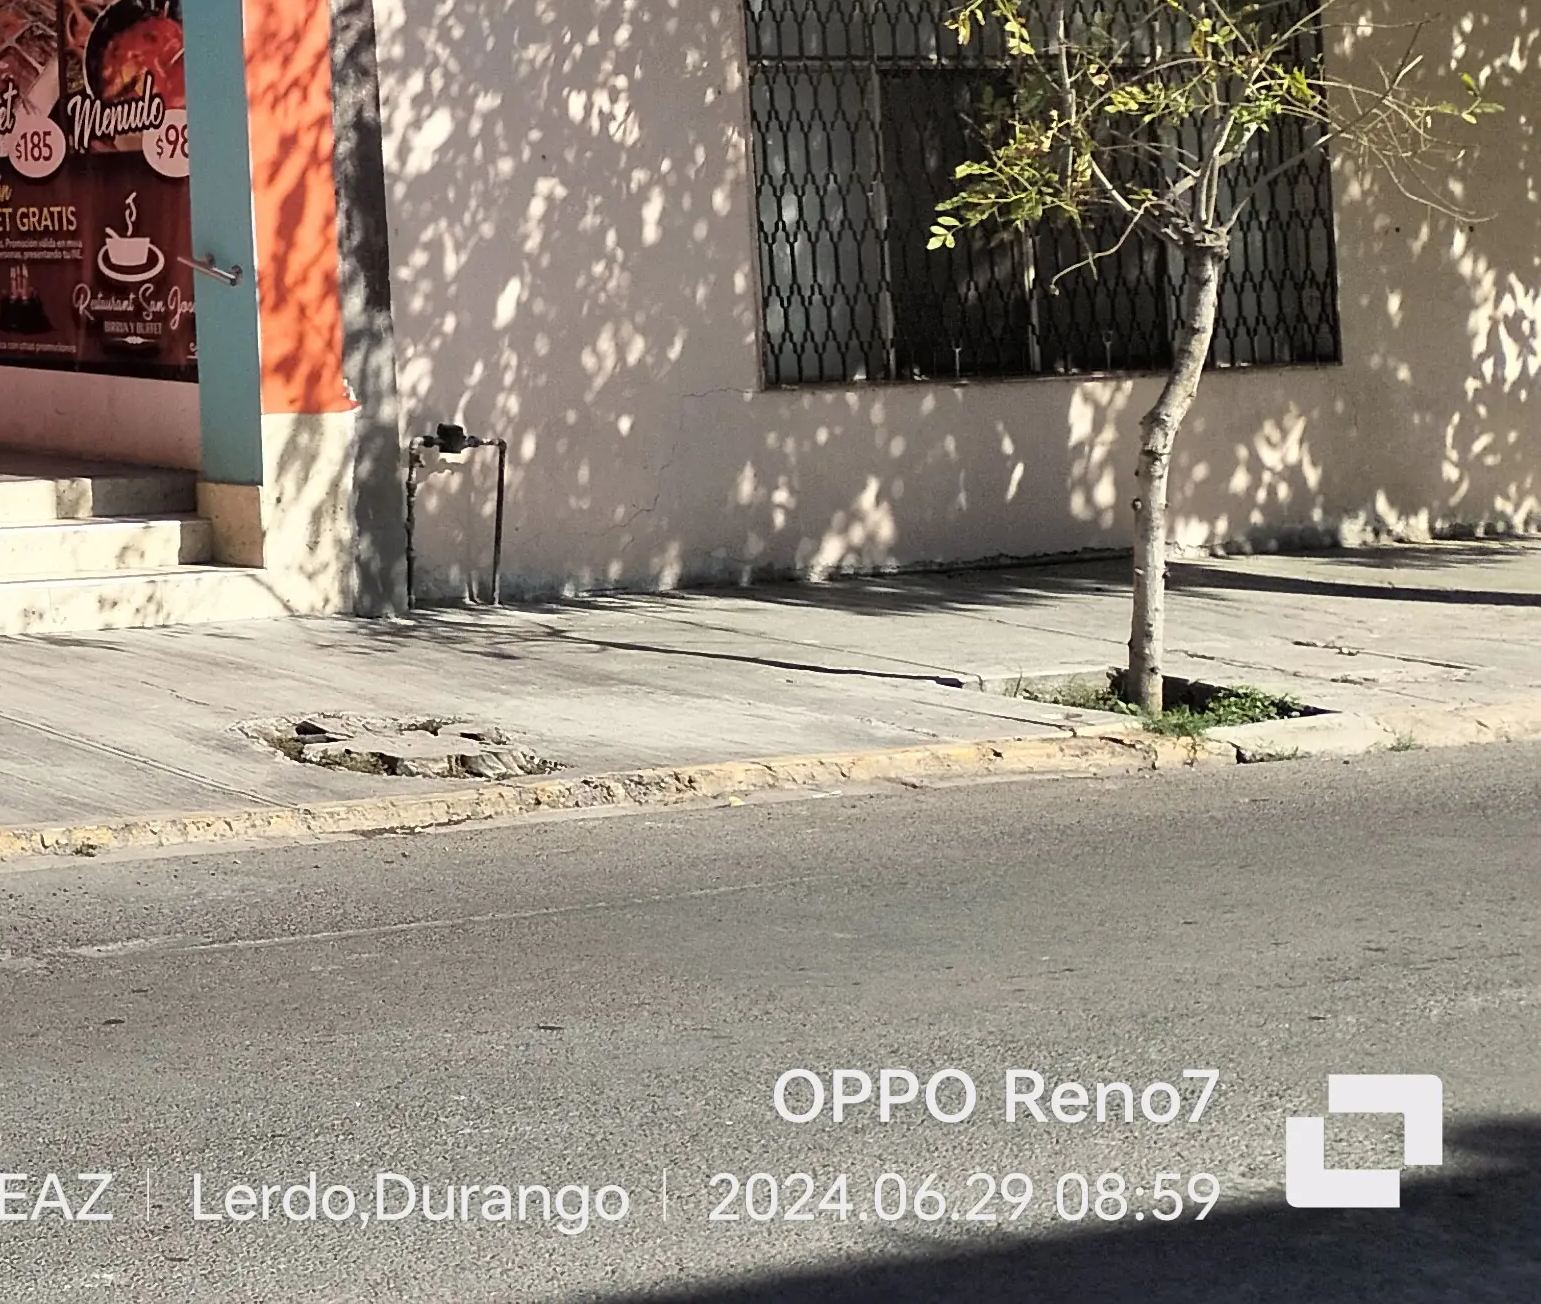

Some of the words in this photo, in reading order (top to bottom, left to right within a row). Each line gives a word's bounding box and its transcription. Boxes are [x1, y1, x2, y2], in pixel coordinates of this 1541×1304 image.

[67, 75, 164, 150] Menudo
[15, 130, 53, 162] $185
[16, 205, 77, 232] GRATIS
[139, 283, 165, 321] San
[167, 285, 195, 330] Jos
